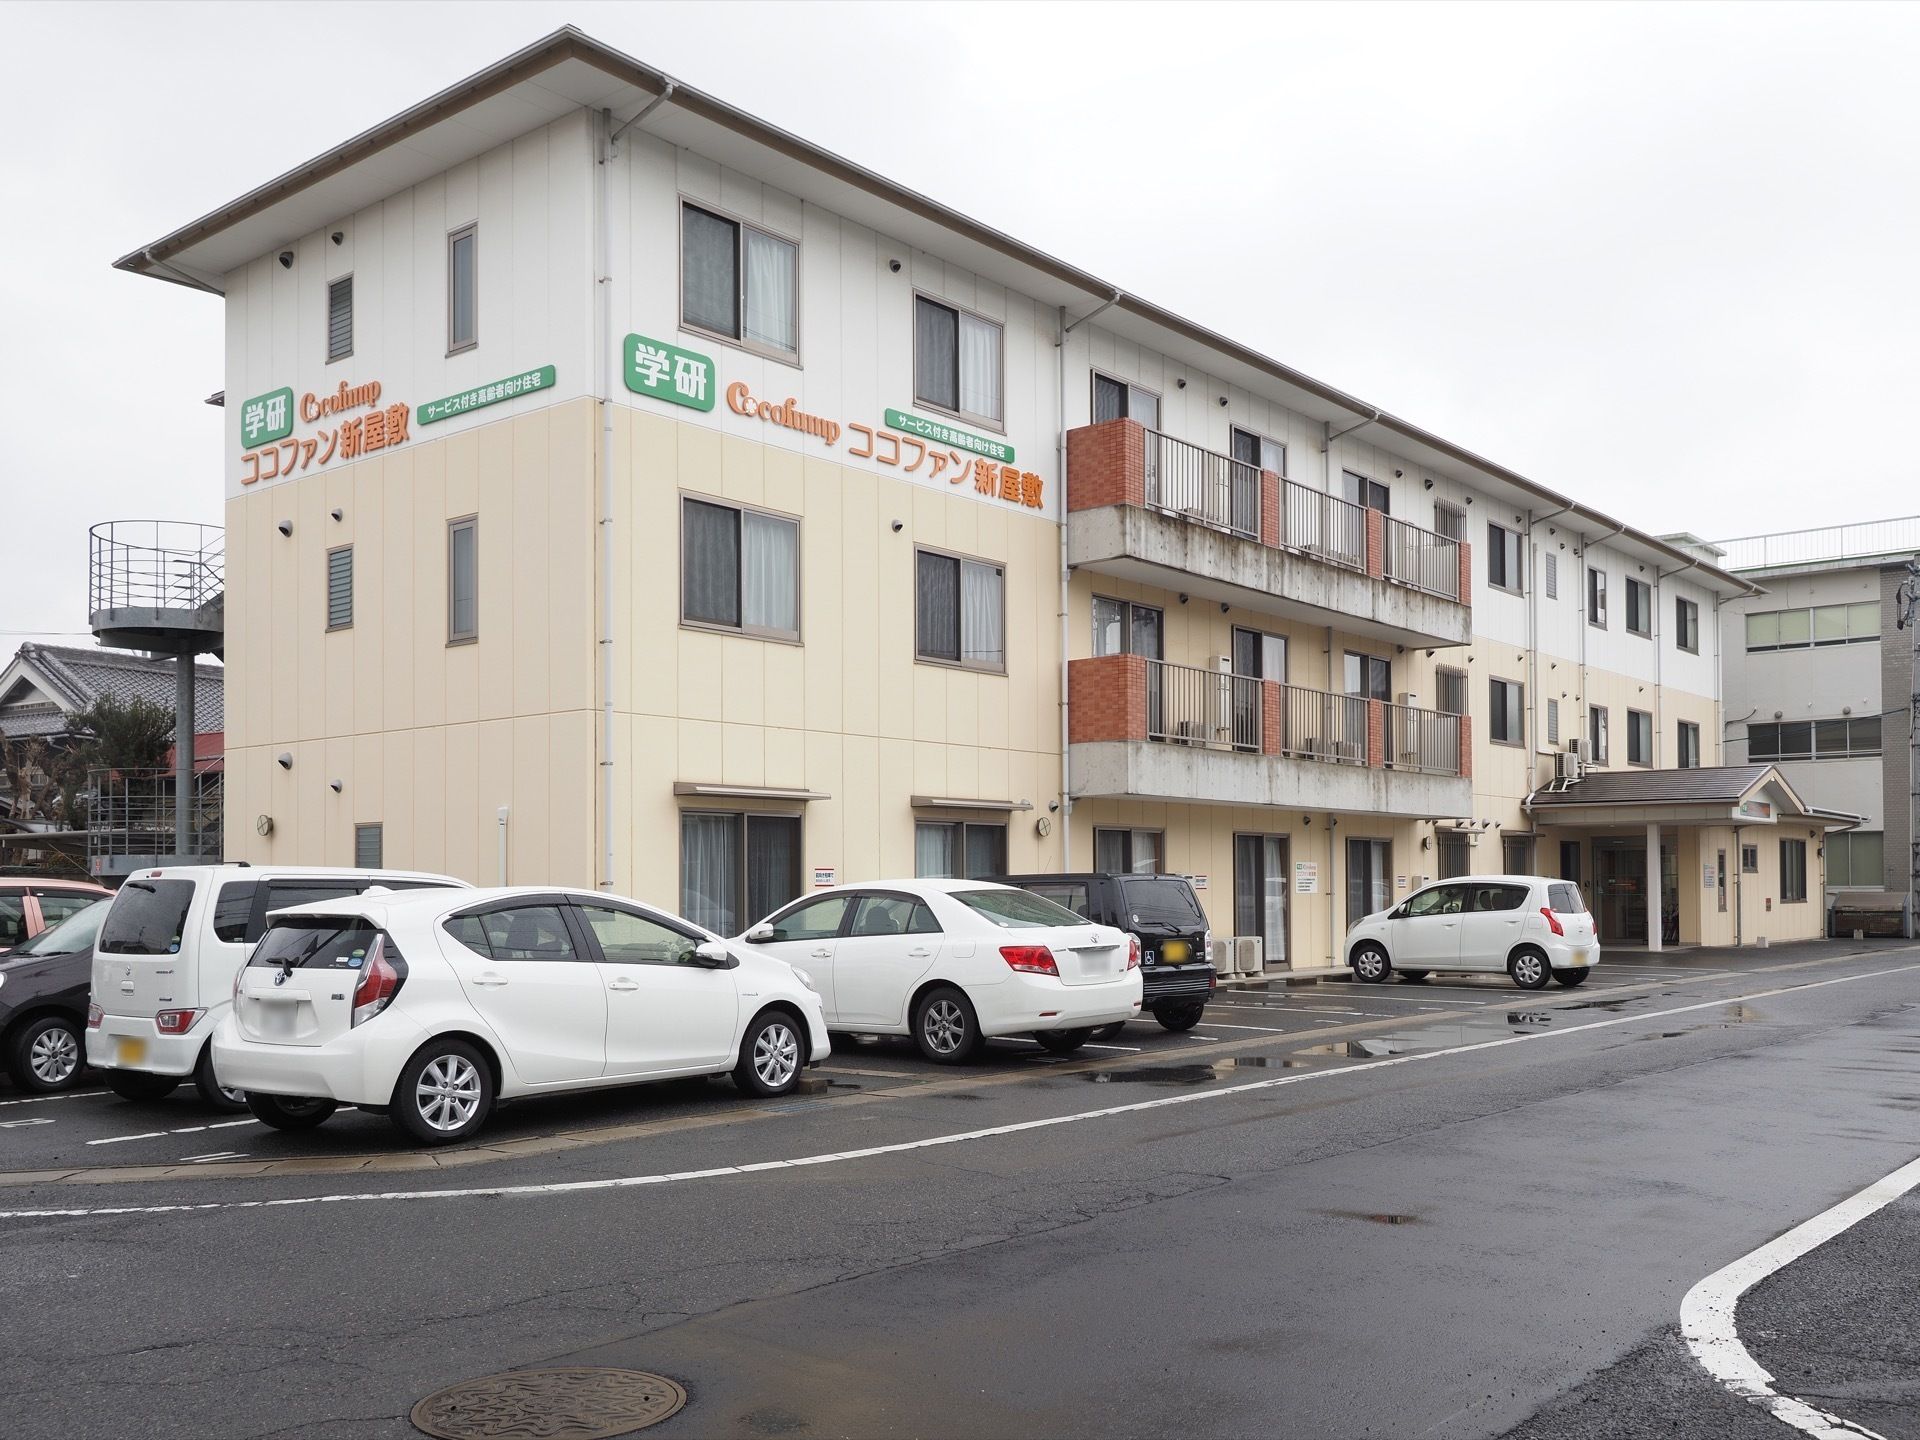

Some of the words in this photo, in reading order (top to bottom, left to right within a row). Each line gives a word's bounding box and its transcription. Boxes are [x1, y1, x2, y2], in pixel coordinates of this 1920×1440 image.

[427, 371, 541, 418] サービス付き高齢者向け住宅
[635, 343, 707, 400] 学研
[245, 394, 287, 439] 学研
[726, 381, 841, 446] Cocofump
[898, 414, 1006, 459] サービス付き高齢者向け住宅
[240, 402, 410, 485] ココファン新屋敷
[848, 421, 1045, 510] ココファン新屋敷
